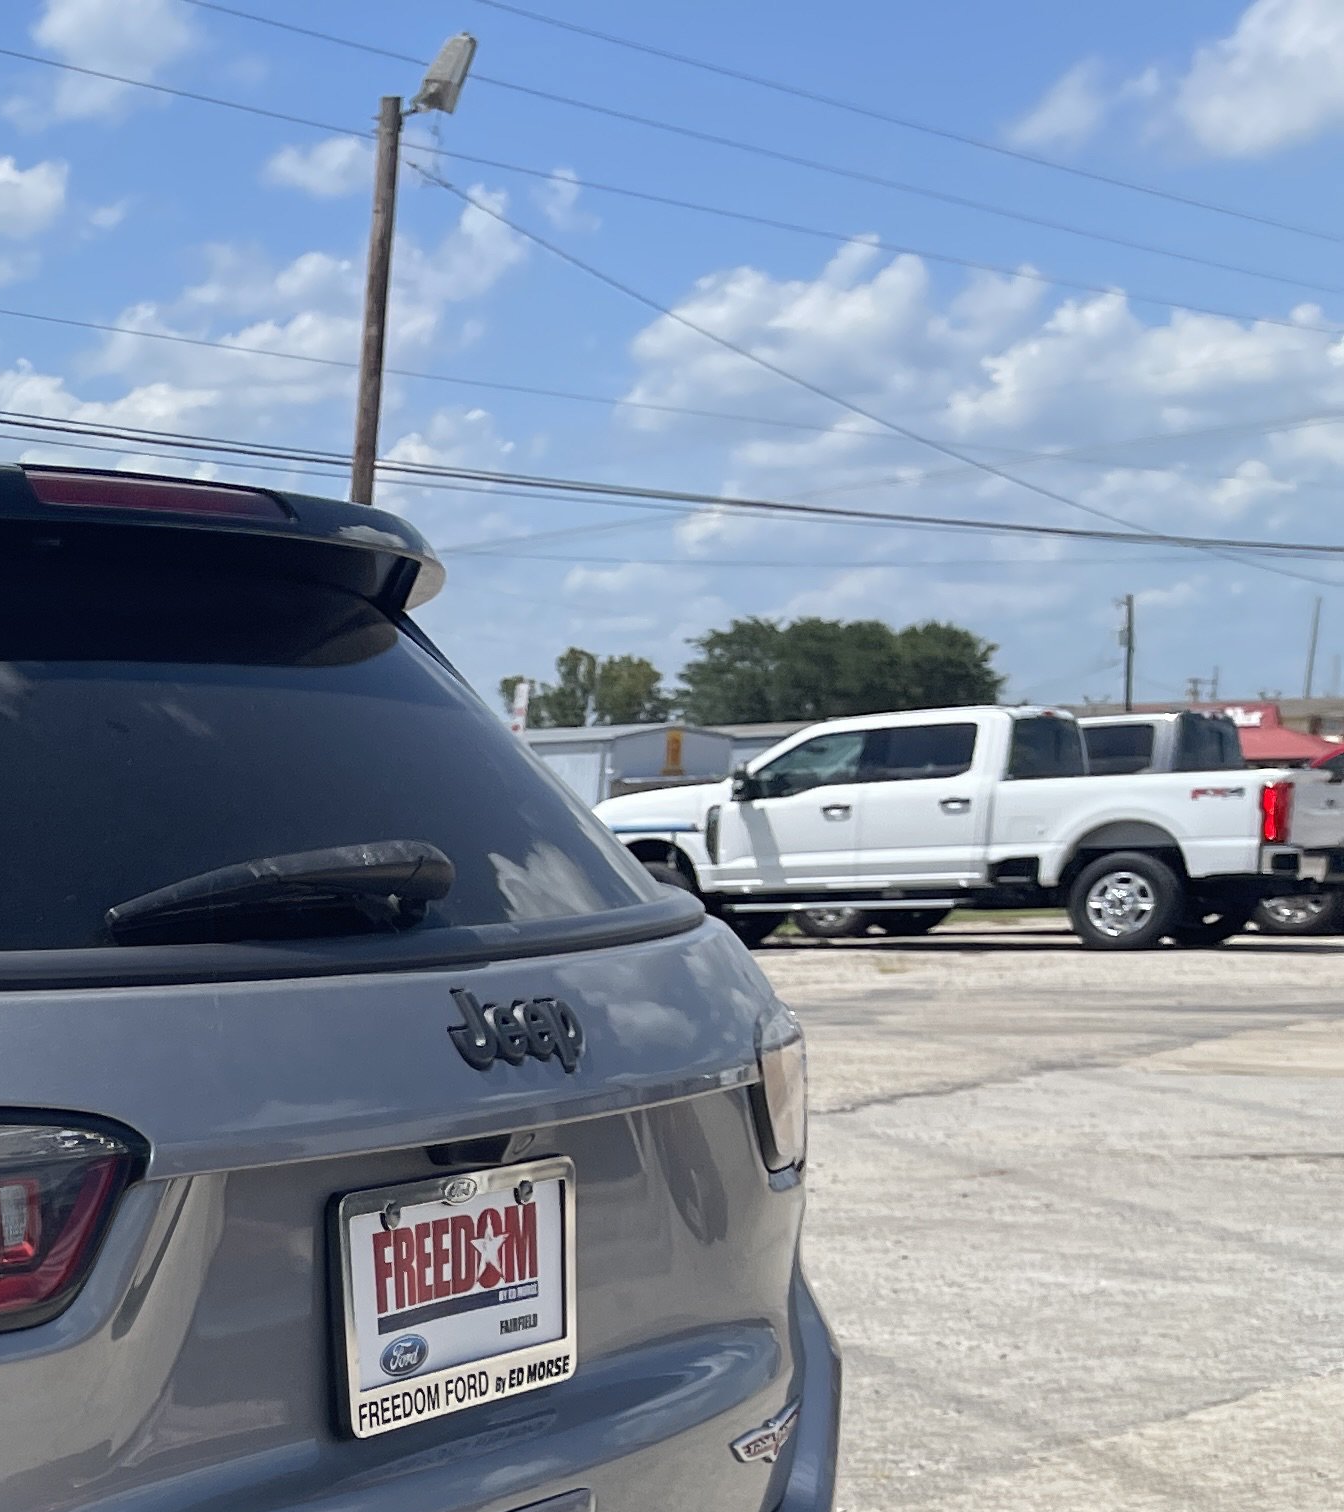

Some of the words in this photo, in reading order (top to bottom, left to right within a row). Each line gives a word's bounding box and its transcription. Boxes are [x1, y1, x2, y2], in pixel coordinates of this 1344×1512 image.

[447, 987, 586, 1074] Jeep
[372, 1201, 540, 1315] FREEDOM
[358, 1383, 440, 1432] FREEDOM
[445, 1371, 490, 1407] FORD
[509, 1367, 524, 1388] ED
[527, 1355, 570, 1384] MORSE
[389, 1341, 420, 1371] Ford
